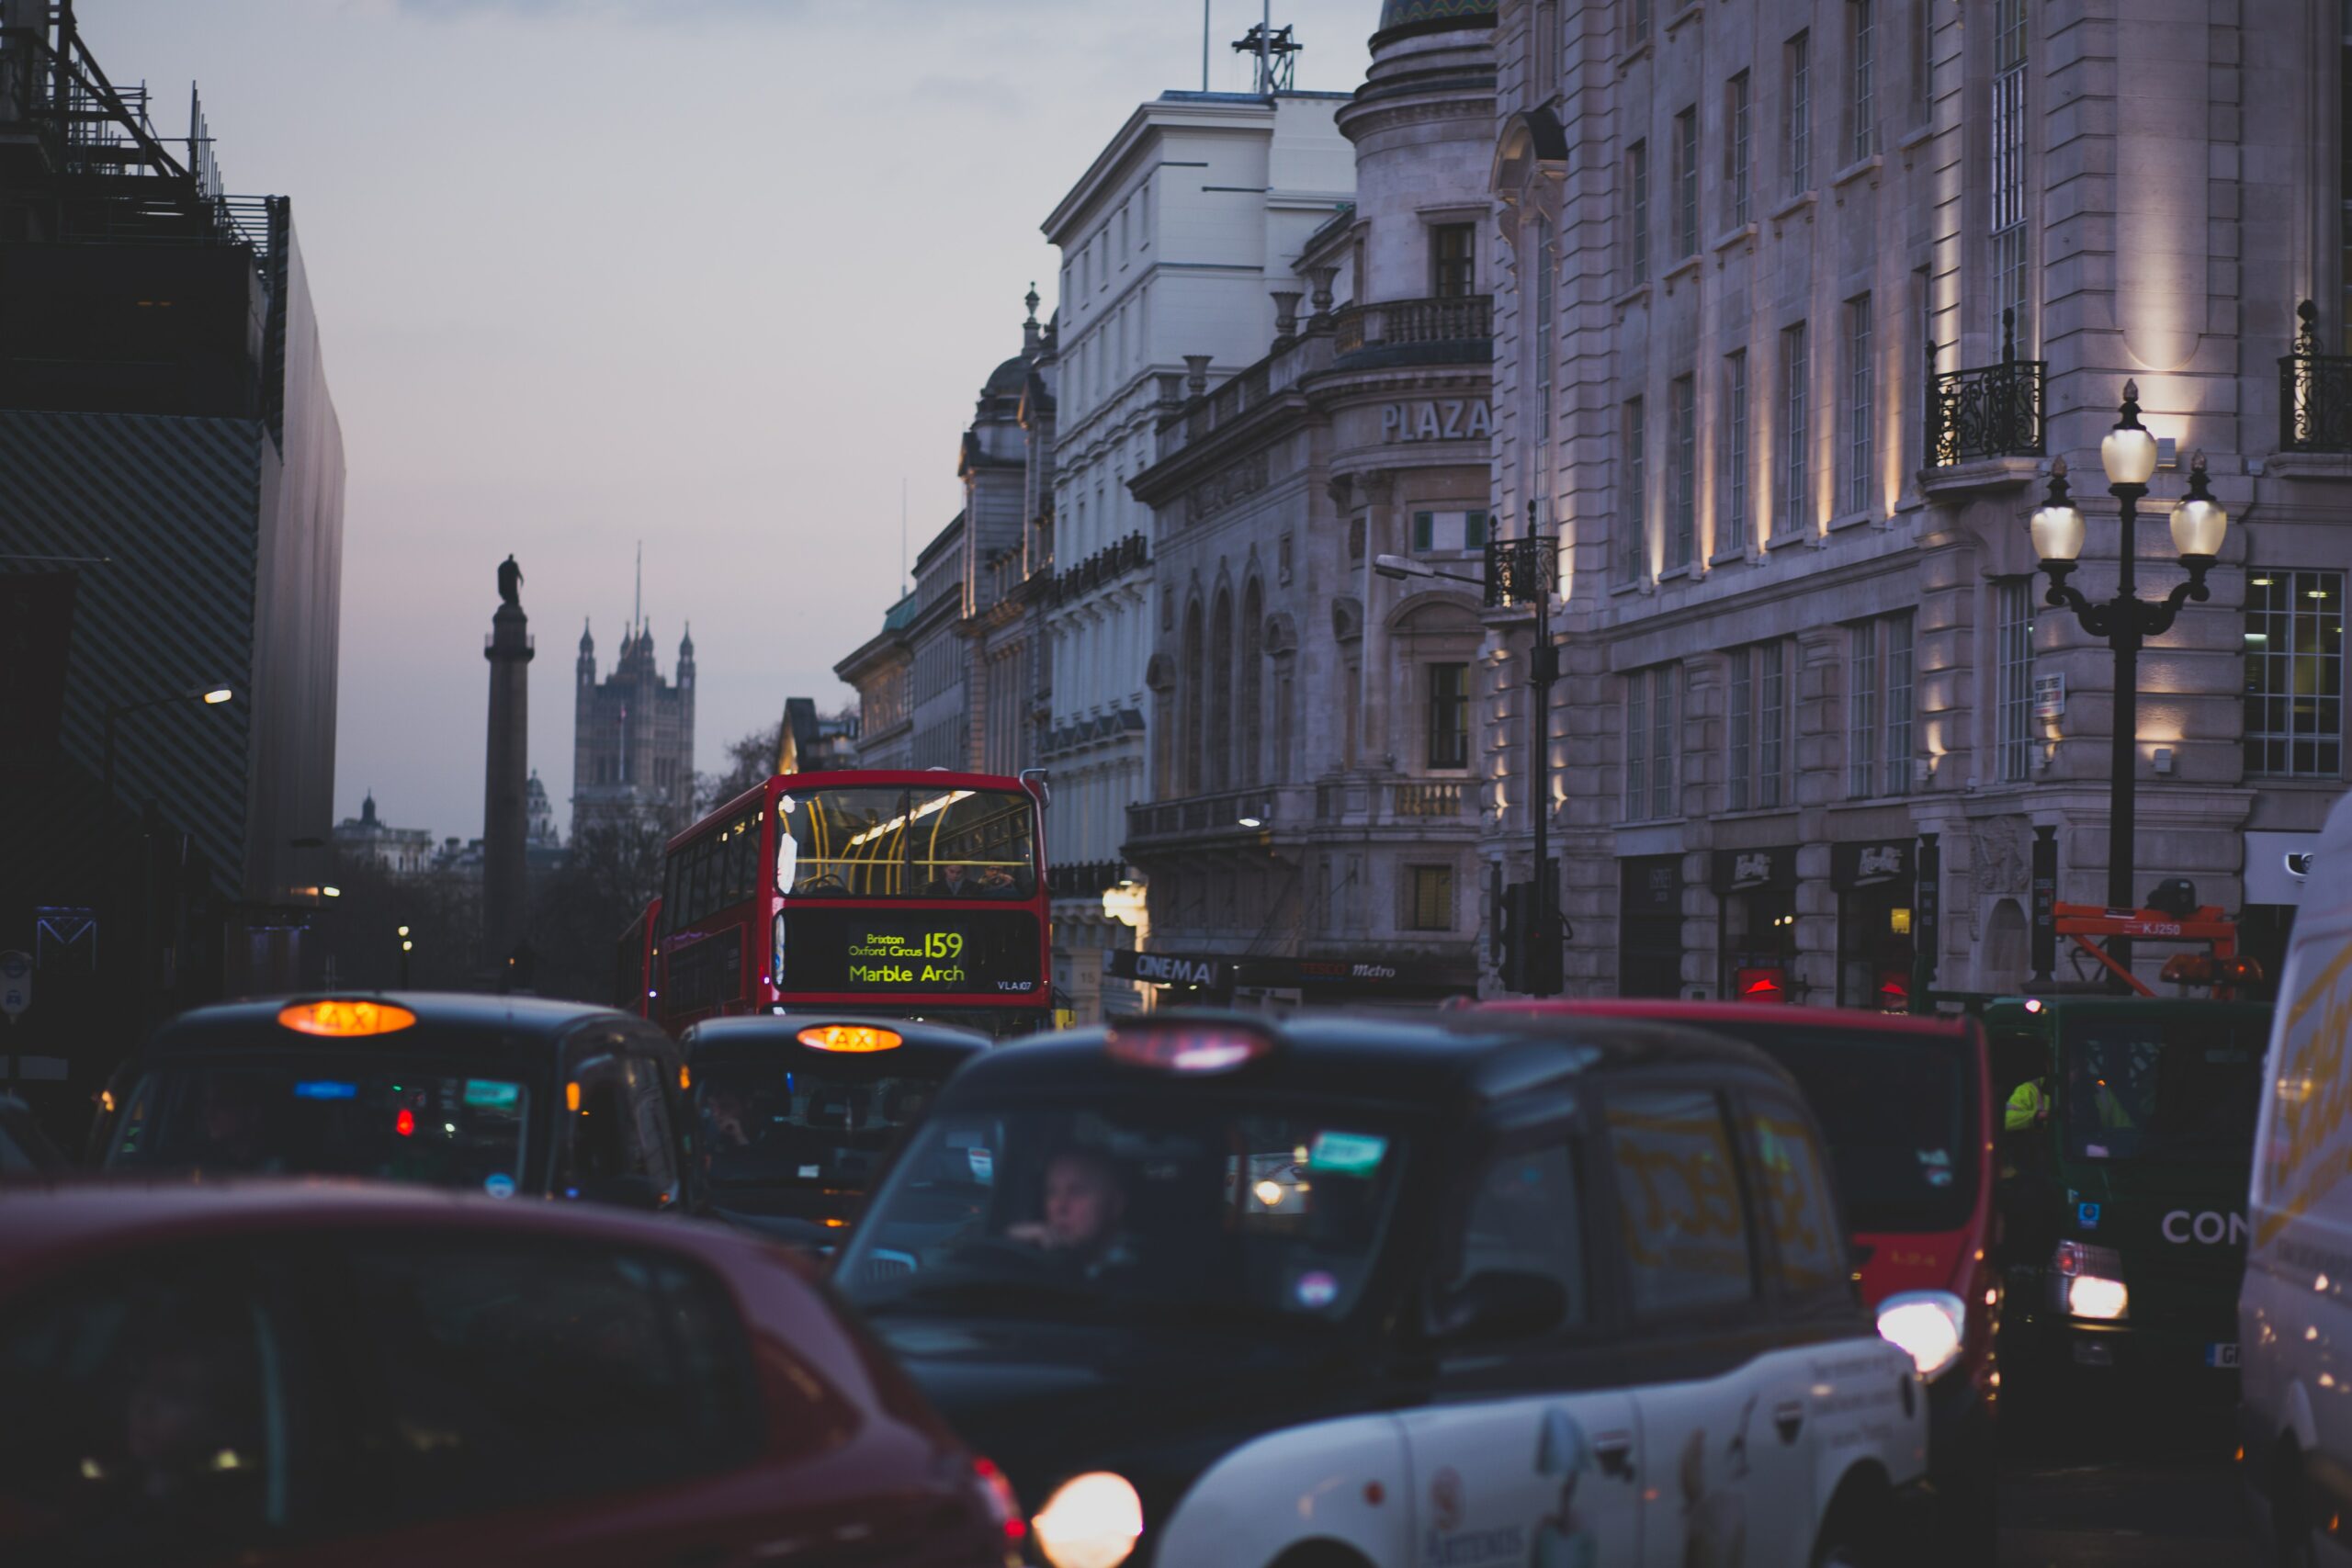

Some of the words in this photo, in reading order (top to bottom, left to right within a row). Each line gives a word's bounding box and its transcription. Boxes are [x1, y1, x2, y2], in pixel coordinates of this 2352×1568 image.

[1383, 399, 1492, 442] PLAZA
[2143, 923, 2180, 935] KJ250
[866, 934, 905, 945] Brixton
[924, 932, 963, 958] 159
[849, 946, 887, 957] Oxford
[889, 946, 922, 957] Circus
[850, 964, 913, 982] Marble
[920, 964, 965, 982] Arch
[1136, 954, 1212, 985] CINEMA
[1300, 962, 1347, 976] TESCO
[1352, 964, 1396, 978] Metro
[309, 1008, 382, 1032] TAXI
[821, 1030, 881, 1047] TAXI
